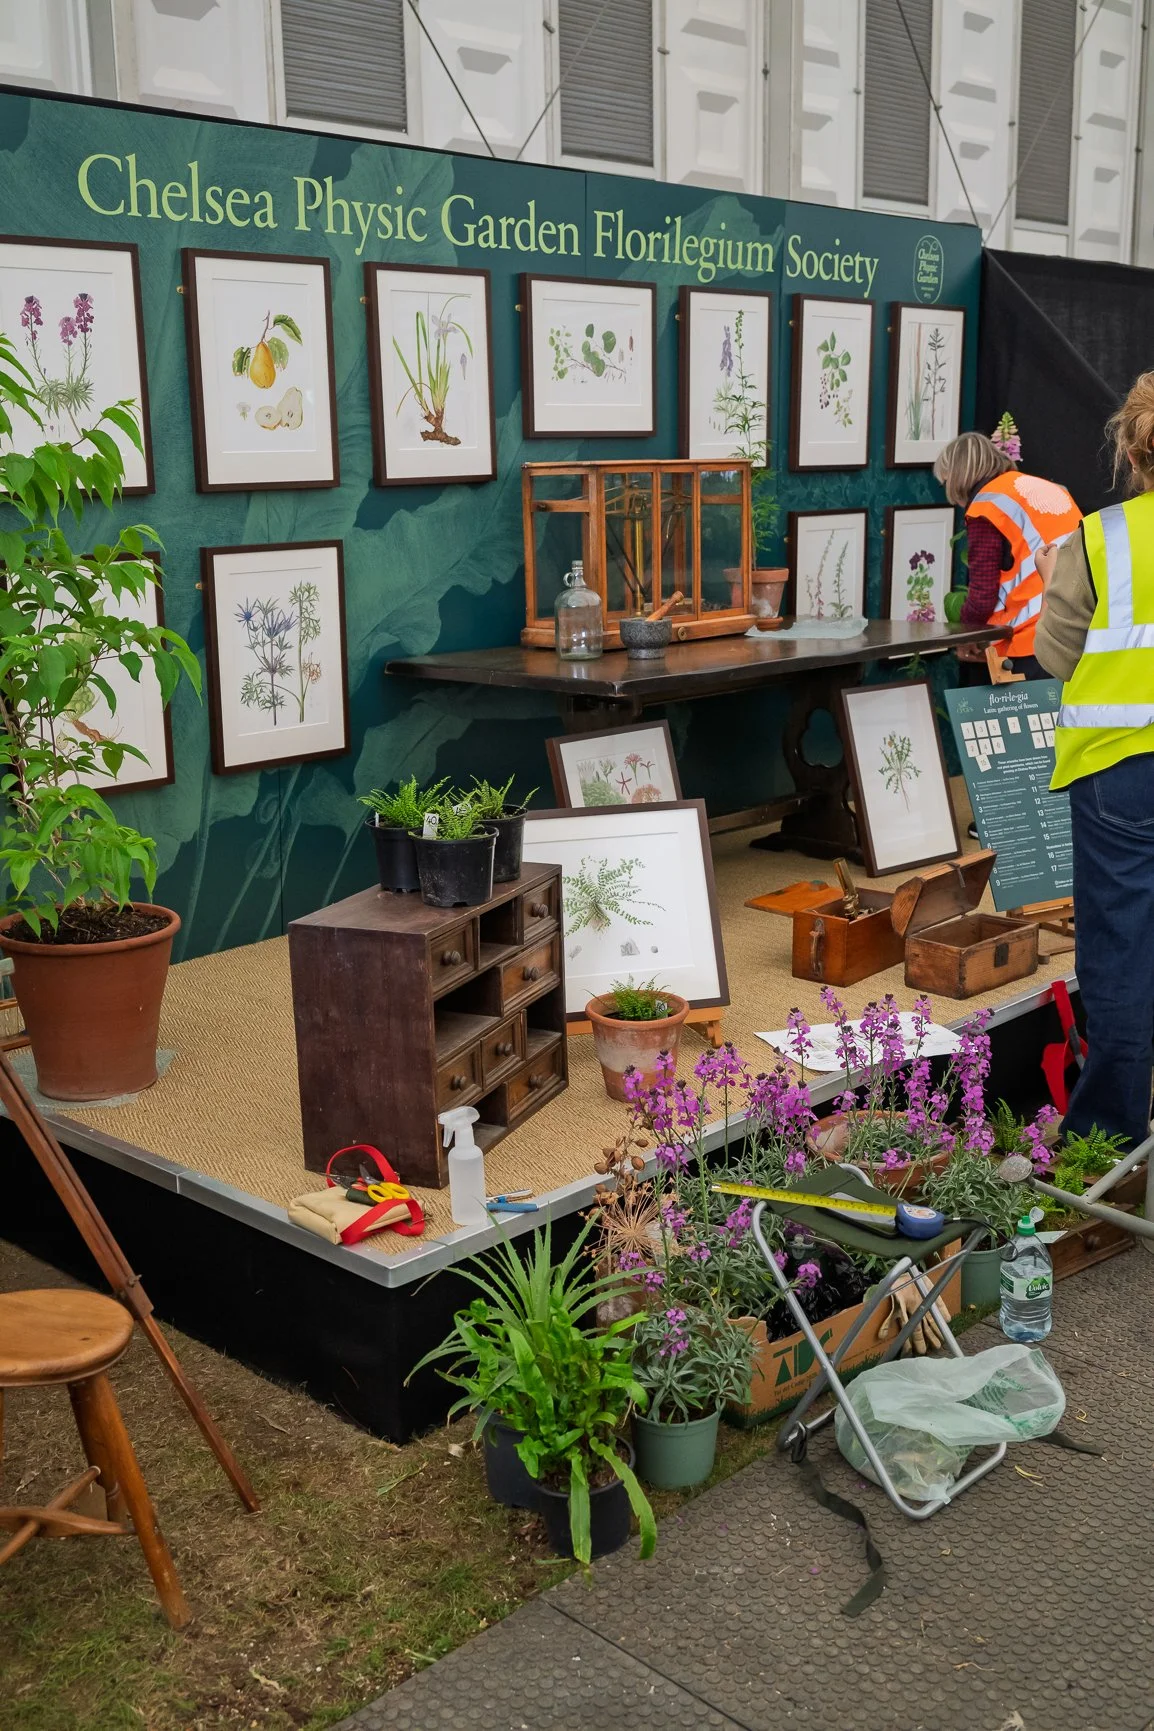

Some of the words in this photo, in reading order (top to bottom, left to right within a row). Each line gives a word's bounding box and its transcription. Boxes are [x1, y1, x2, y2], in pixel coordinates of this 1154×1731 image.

[77, 153, 278, 229] Chelsea
[293, 176, 427, 256] Physic
[441, 194, 581, 256] Garden
[593, 208, 775, 283] Florilegium
[786, 234, 879, 298] Society
